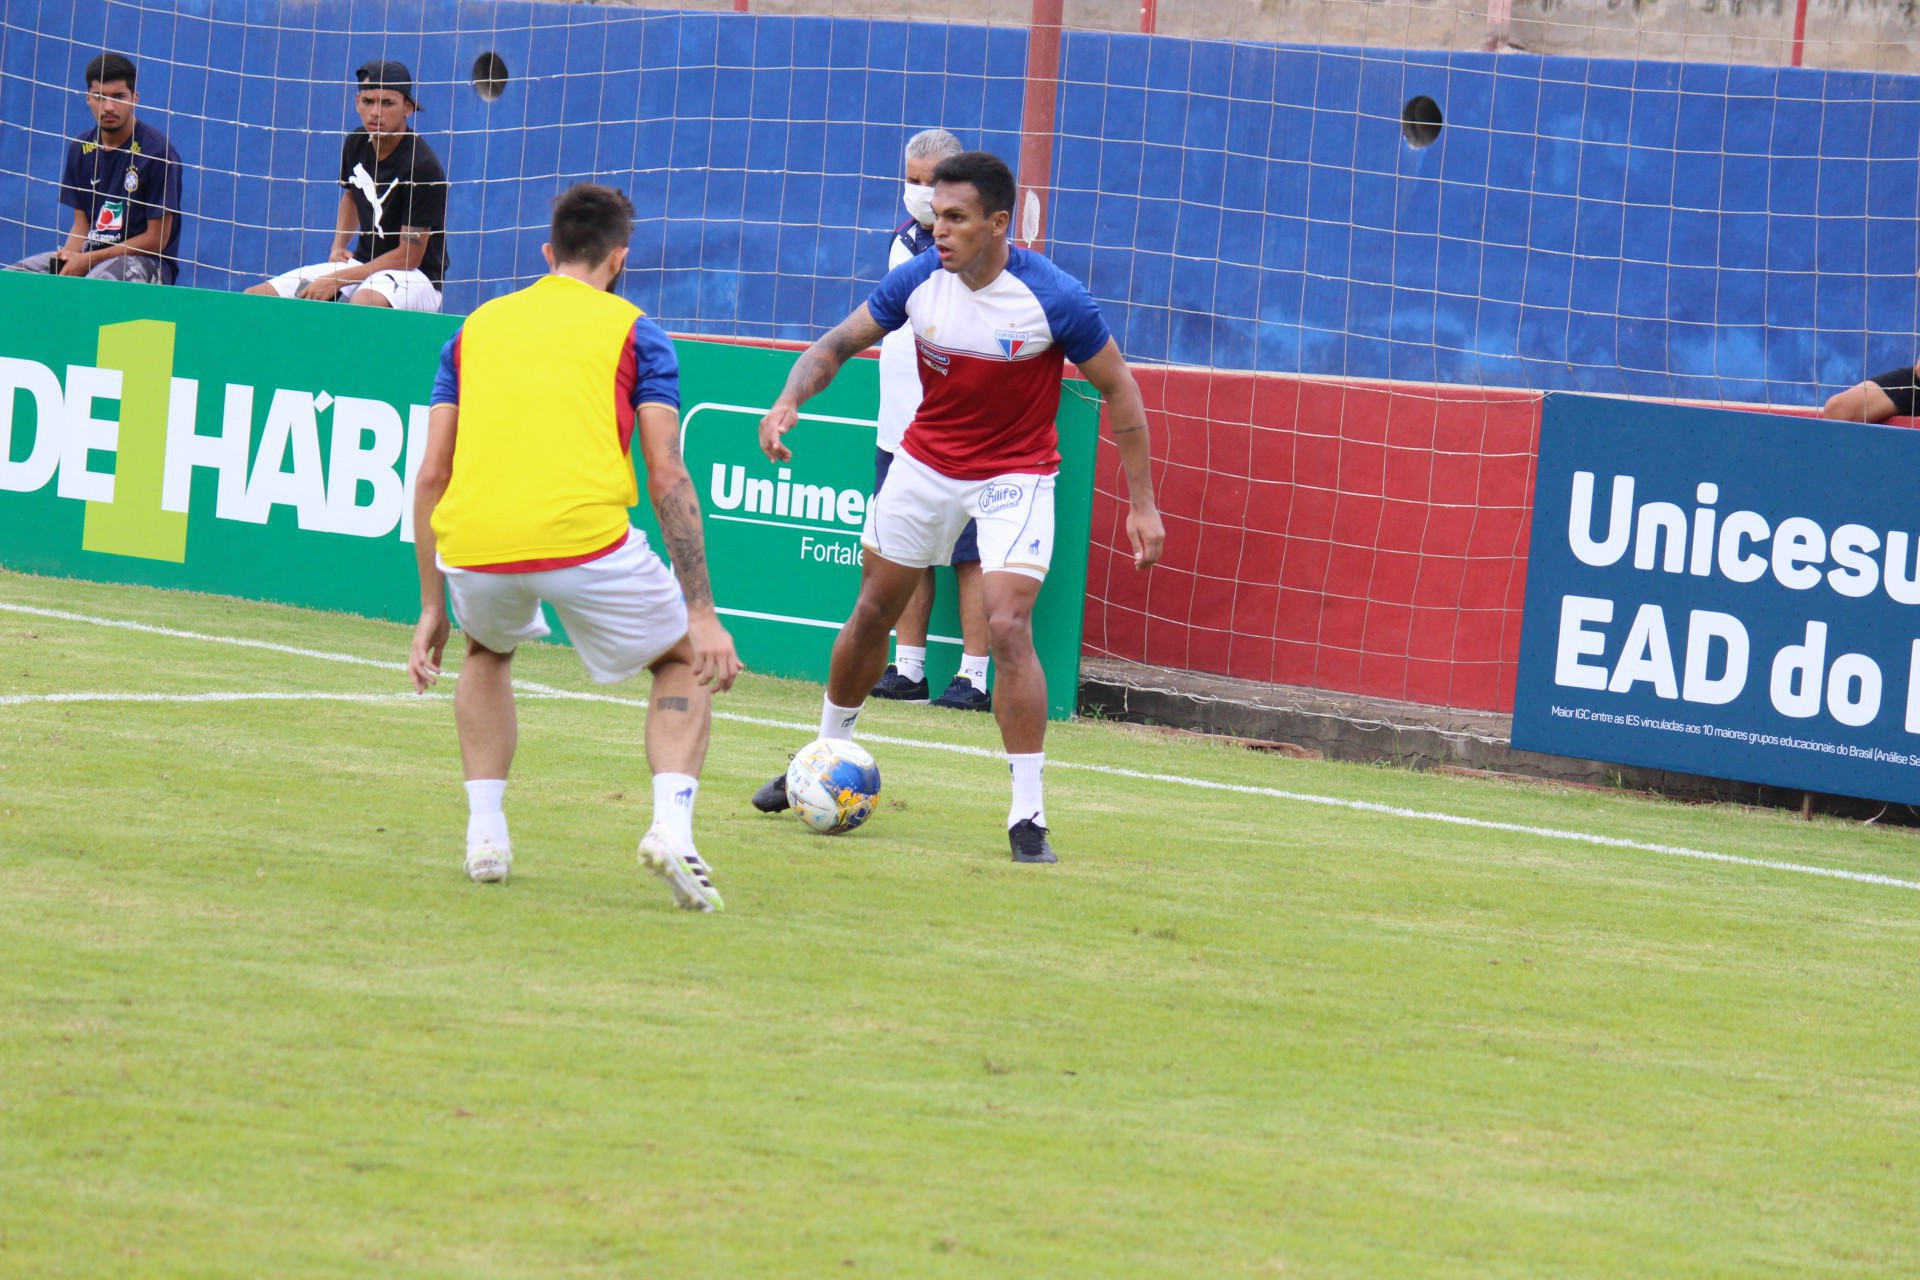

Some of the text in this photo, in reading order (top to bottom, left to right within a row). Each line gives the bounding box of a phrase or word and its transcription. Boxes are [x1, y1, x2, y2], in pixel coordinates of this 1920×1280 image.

[0, 356, 124, 504] DE
[82, 319, 176, 563] 1
[1568, 470, 1920, 605] Unicesu
[1554, 594, 1750, 705] EAD
[1769, 620, 1883, 727] do
[1551, 705, 1574, 718] Maior
[1575, 708, 1590, 720] IGC
[1591, 712, 1613, 724] entre
[1614, 715, 1625, 725] as
[1626, 714, 1640, 727] IES
[1641, 718, 1684, 733] vinculadas
[1685, 724, 1701, 734] aos
[1702, 724, 1714, 736] 10
[1715, 726, 1748, 741] maiores
[1748, 731, 1779, 746] grupos
[1780, 735, 1836, 754] educacionais
[1837, 743, 1848, 756] do
[1849, 745, 1874, 760] Brasil
[1874, 747, 1908, 765] (Análise
